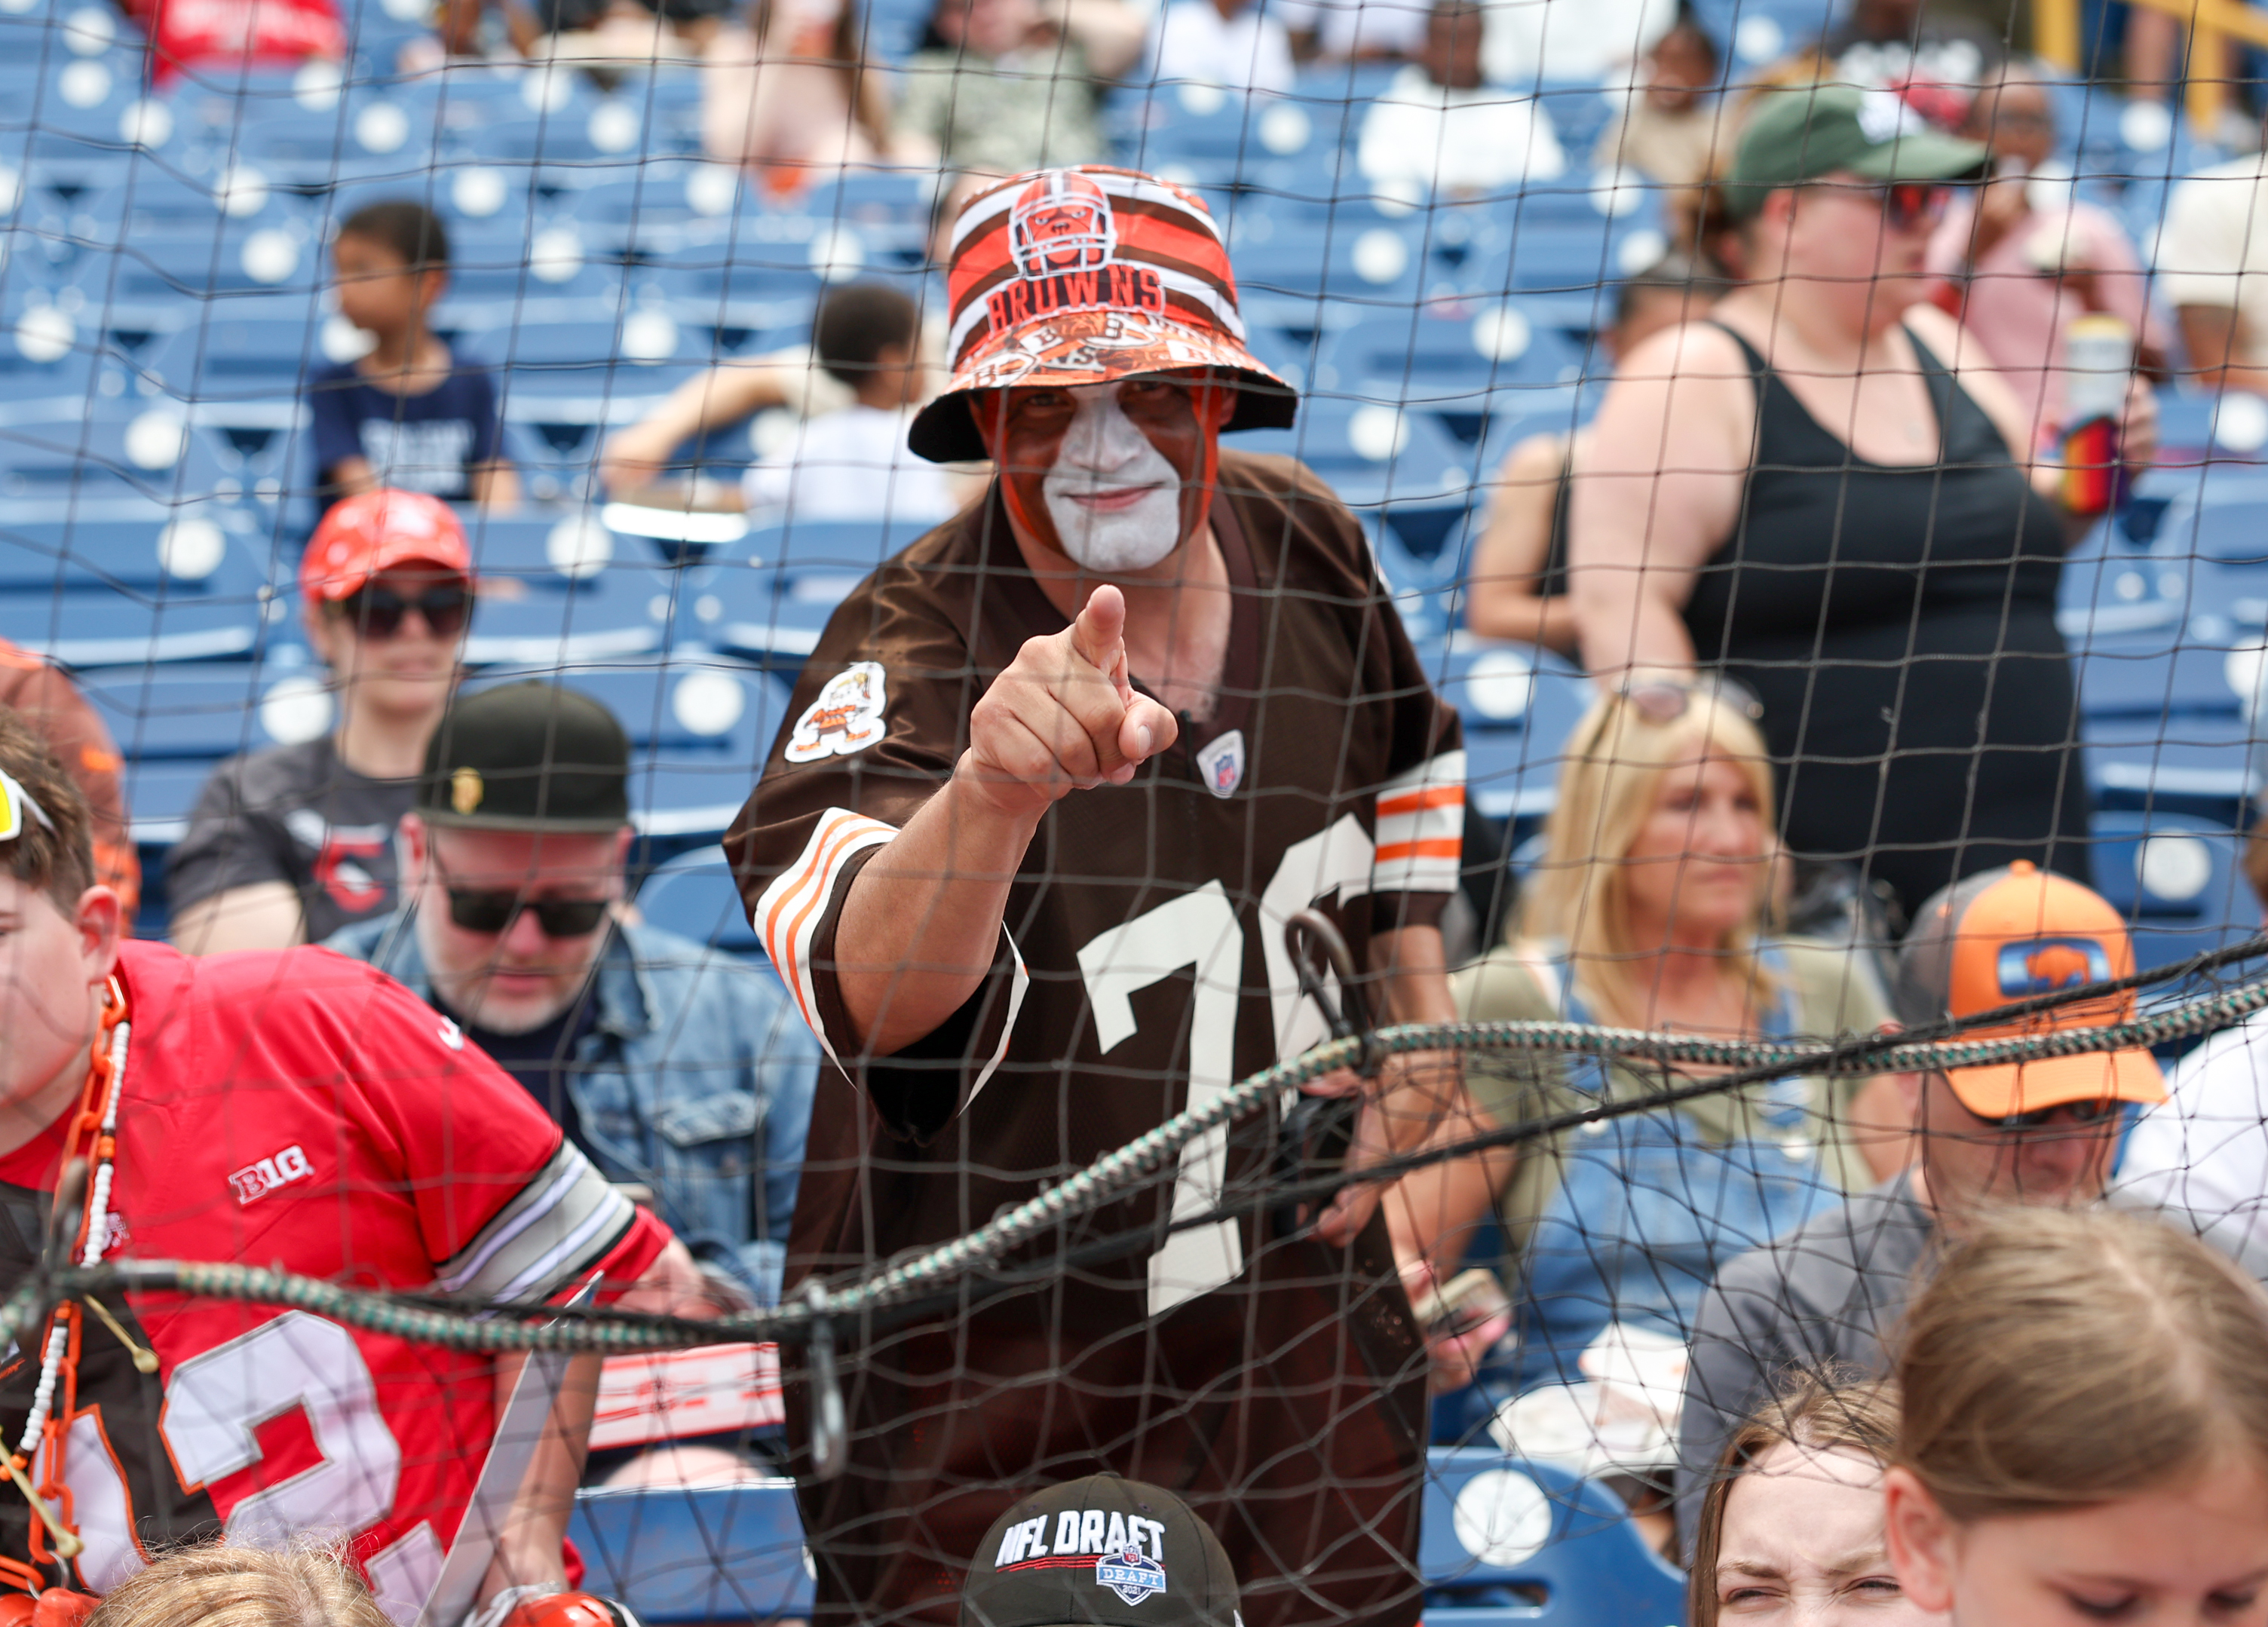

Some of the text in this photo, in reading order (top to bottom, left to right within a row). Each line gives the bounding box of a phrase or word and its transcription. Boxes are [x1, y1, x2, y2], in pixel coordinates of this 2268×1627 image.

[986, 265, 1162, 332] BROWNS
[995, 1509, 1166, 1567] NFL DRAFT
[1102, 1568, 1159, 1586] DRAFT
[1122, 1584, 1142, 1595] 2021
